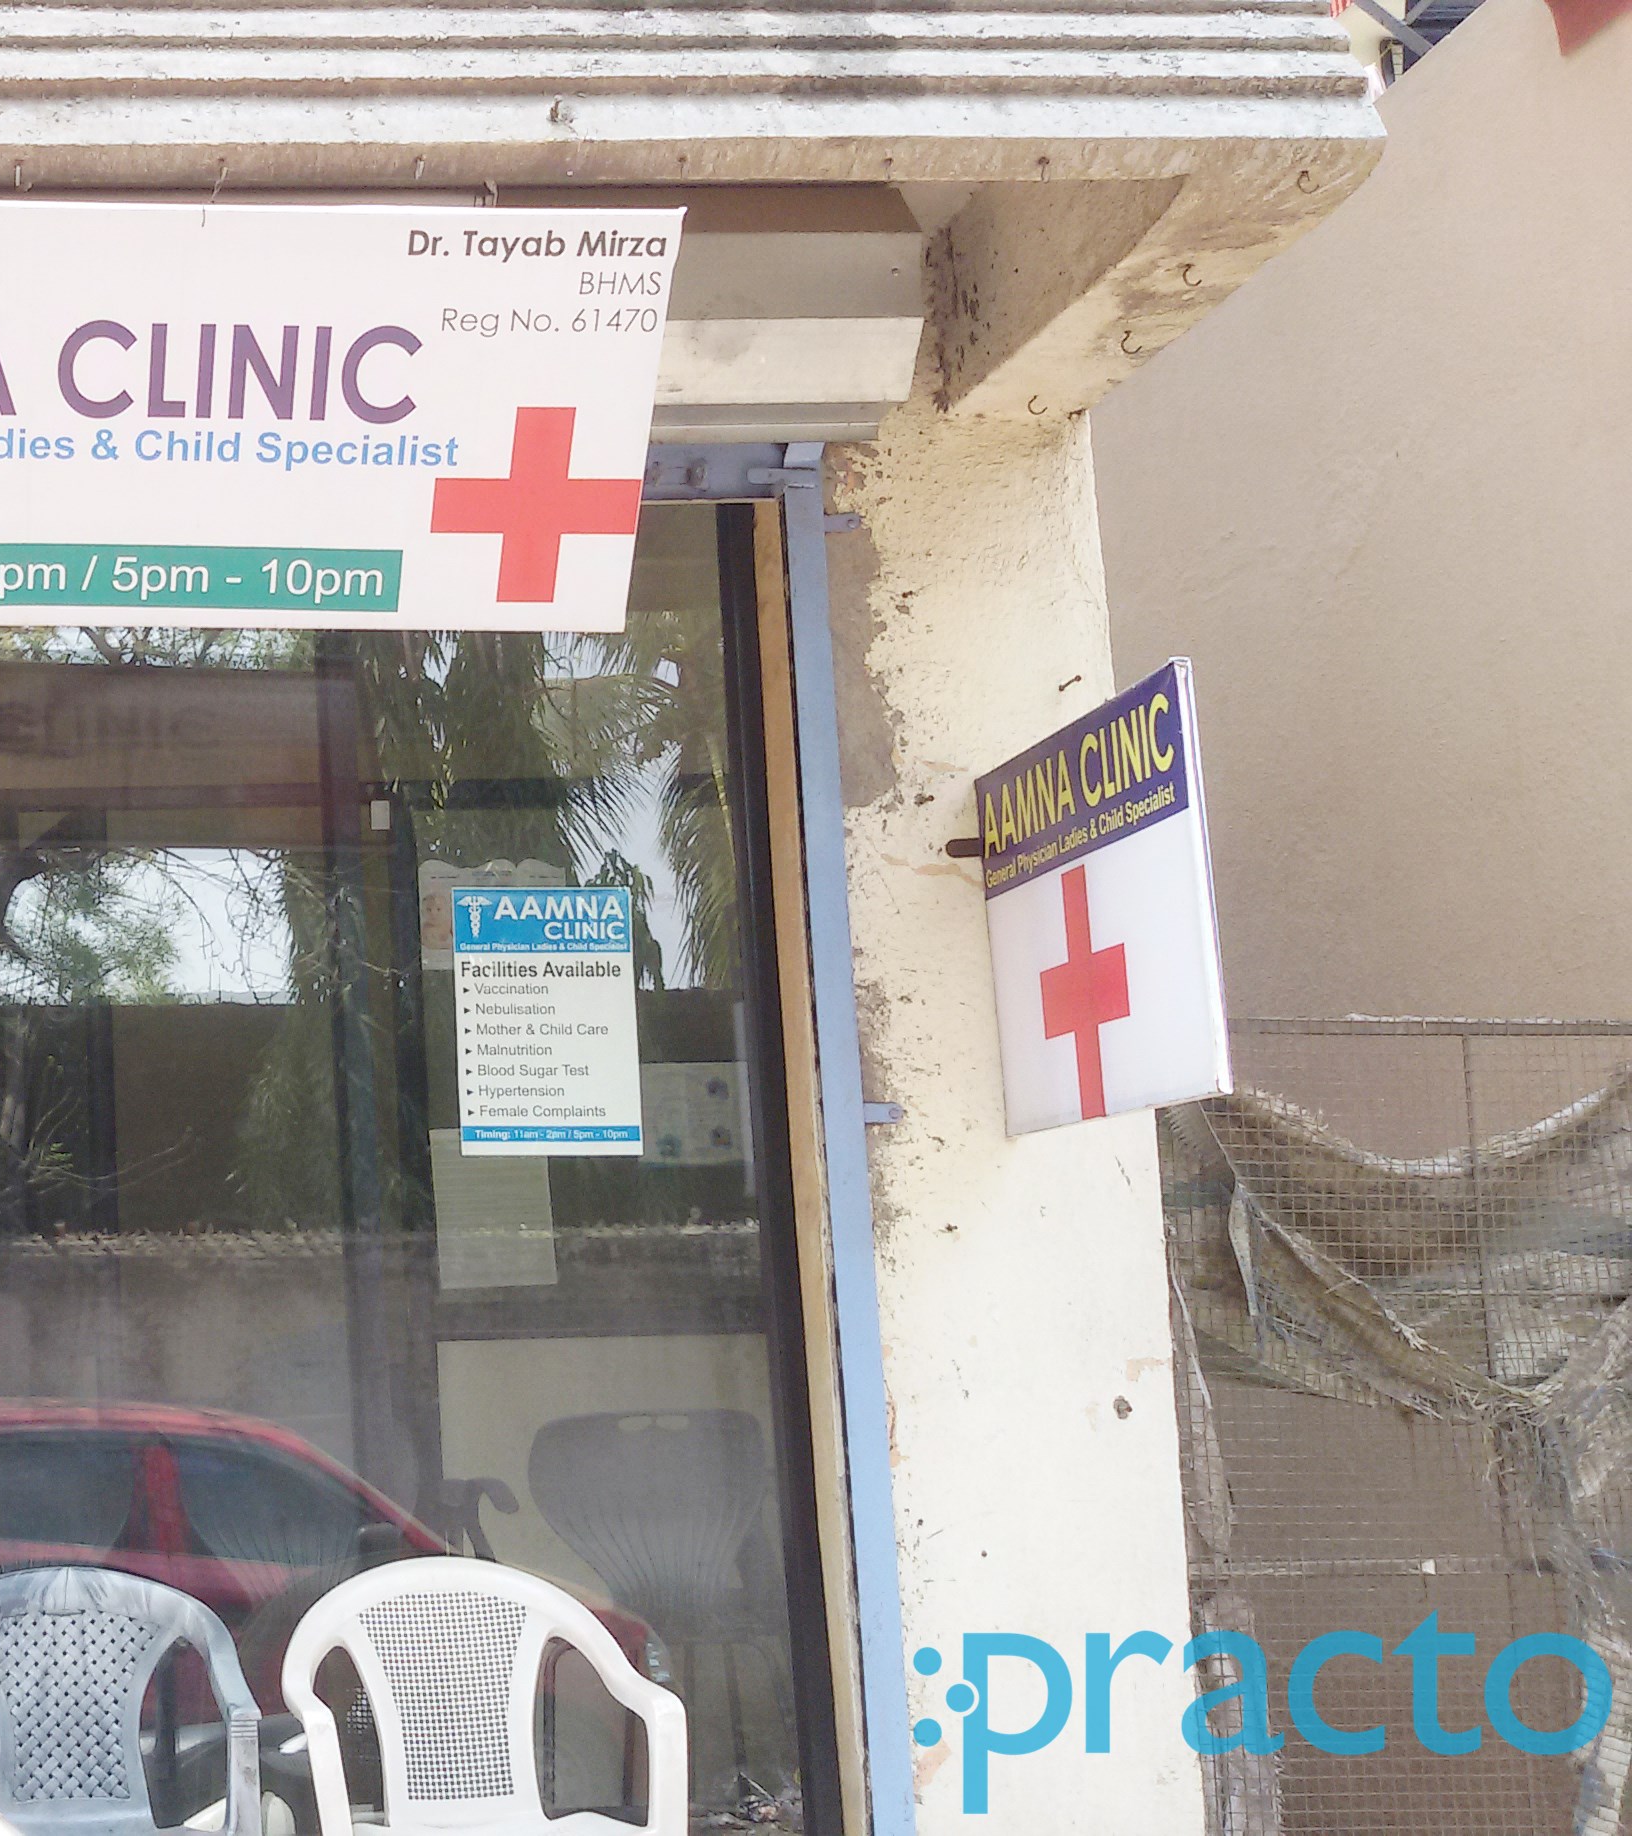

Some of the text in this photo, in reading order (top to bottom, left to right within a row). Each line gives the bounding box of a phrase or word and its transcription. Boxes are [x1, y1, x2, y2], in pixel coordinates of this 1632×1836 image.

[408, 230, 667, 262] Dr. Tayab Mirza
[580, 272, 662, 296] BHMS
[441, 308, 658, 337] Reg No. 61470
[58, 319, 422, 425] CLINIC
[91, 430, 119, 460] &
[135, 430, 240, 462] Child
[256, 432, 459, 471] Specialist
[82, 555, 98, 592] /
[112, 558, 210, 600] 5pm
[262, 560, 383, 603] 10pm
[984, 693, 1174, 859] AAMNA CLINIC
[986, 782, 1175, 888] General Physician Ladies & Child Specialist
[494, 895, 624, 920] AAMNA
[544, 921, 625, 940] CLINIC
[461, 961, 621, 978] Facilities Available
[474, 983, 549, 995] Vaccination
[476, 1003, 556, 1015] Nebulisation
[476, 1024, 609, 1036] Mother & Child Care
[477, 1044, 552, 1056] Malnutrition
[478, 1065, 589, 1079] Blood Sugar Test
[478, 1085, 565, 1099] Hypertension
[480, 1105, 606, 1119] Female Complaints
[475, 1130, 511, 1140] Timing:
